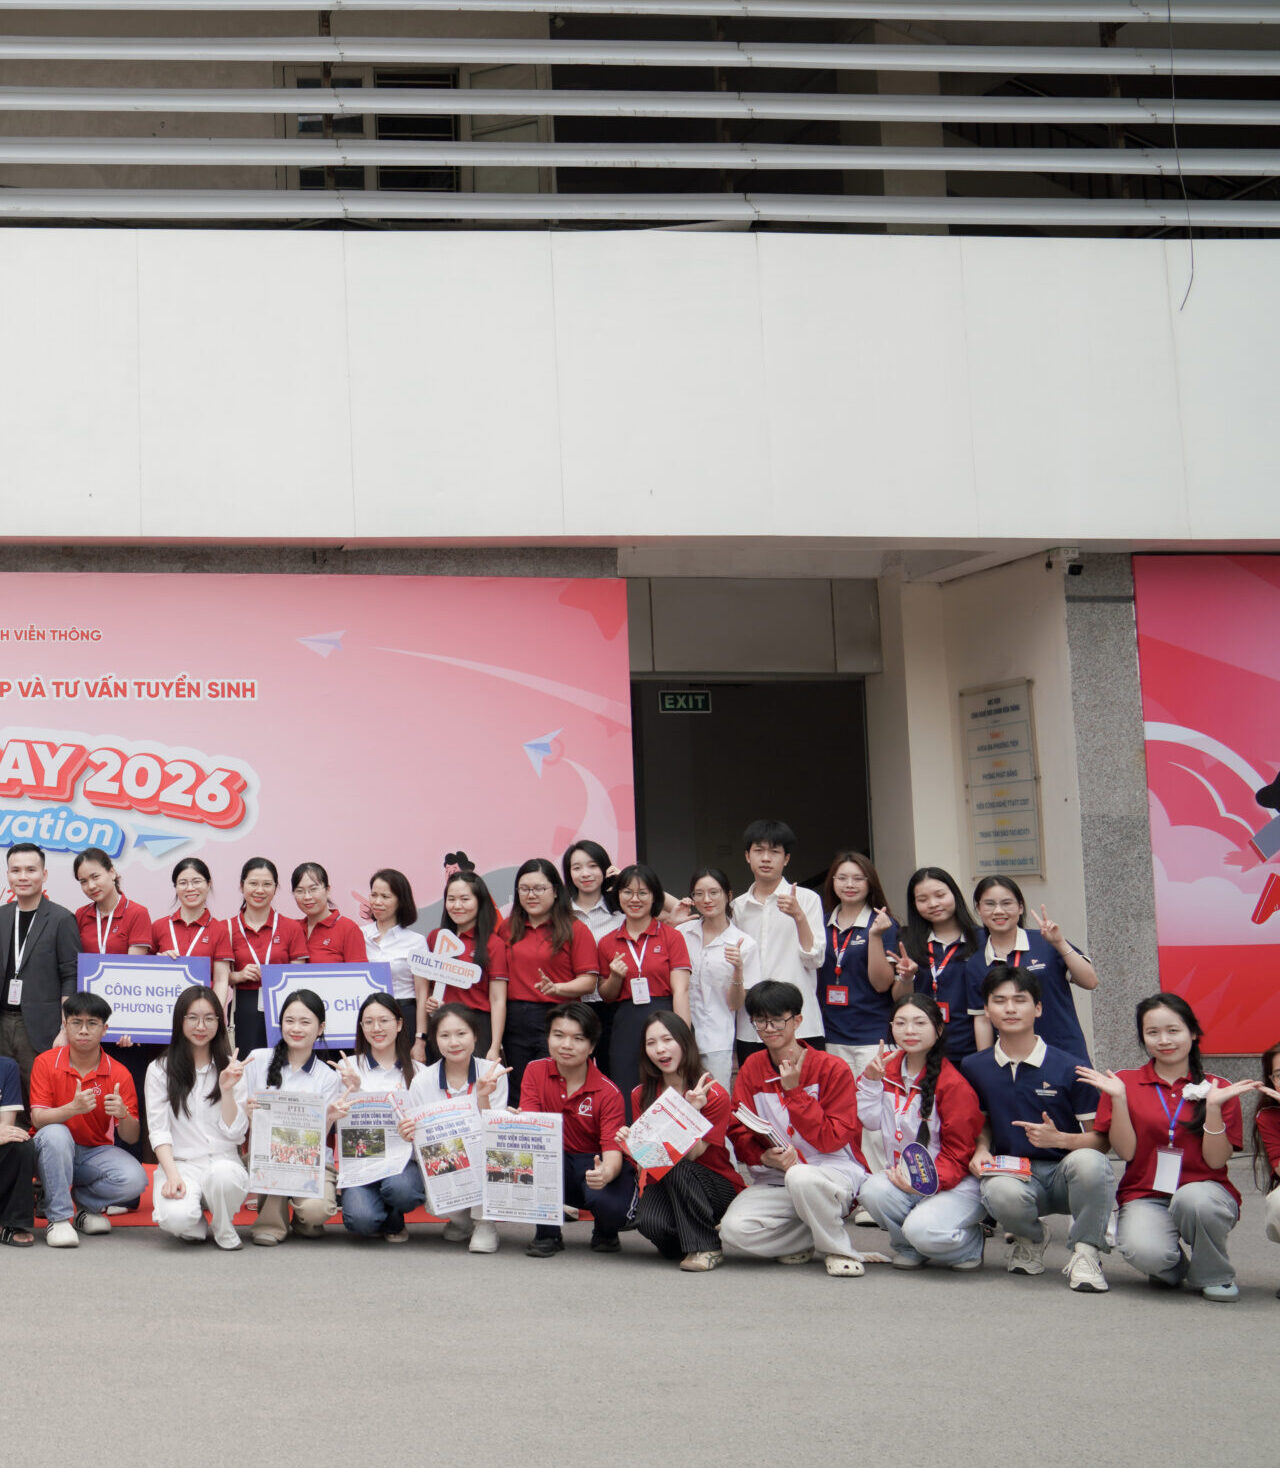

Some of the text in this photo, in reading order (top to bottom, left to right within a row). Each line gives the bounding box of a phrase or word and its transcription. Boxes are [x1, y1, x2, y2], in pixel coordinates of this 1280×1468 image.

[14, 625, 46, 641] VIỄN
[50, 627, 102, 641] THÔNG
[18, 676, 46, 698] VÀ
[52, 680, 80, 698] TƯ
[85, 675, 127, 698] VẤN
[133, 674, 201, 698] TUYỂN
[207, 680, 256, 699] SINH
[665, 695, 705, 709] EXIT
[84, 748, 240, 820] 2026
[104, 982, 142, 996] CÔNG
[113, 1002, 164, 1014] PHƯƠNG
[334, 996, 361, 1012] CHÍ
